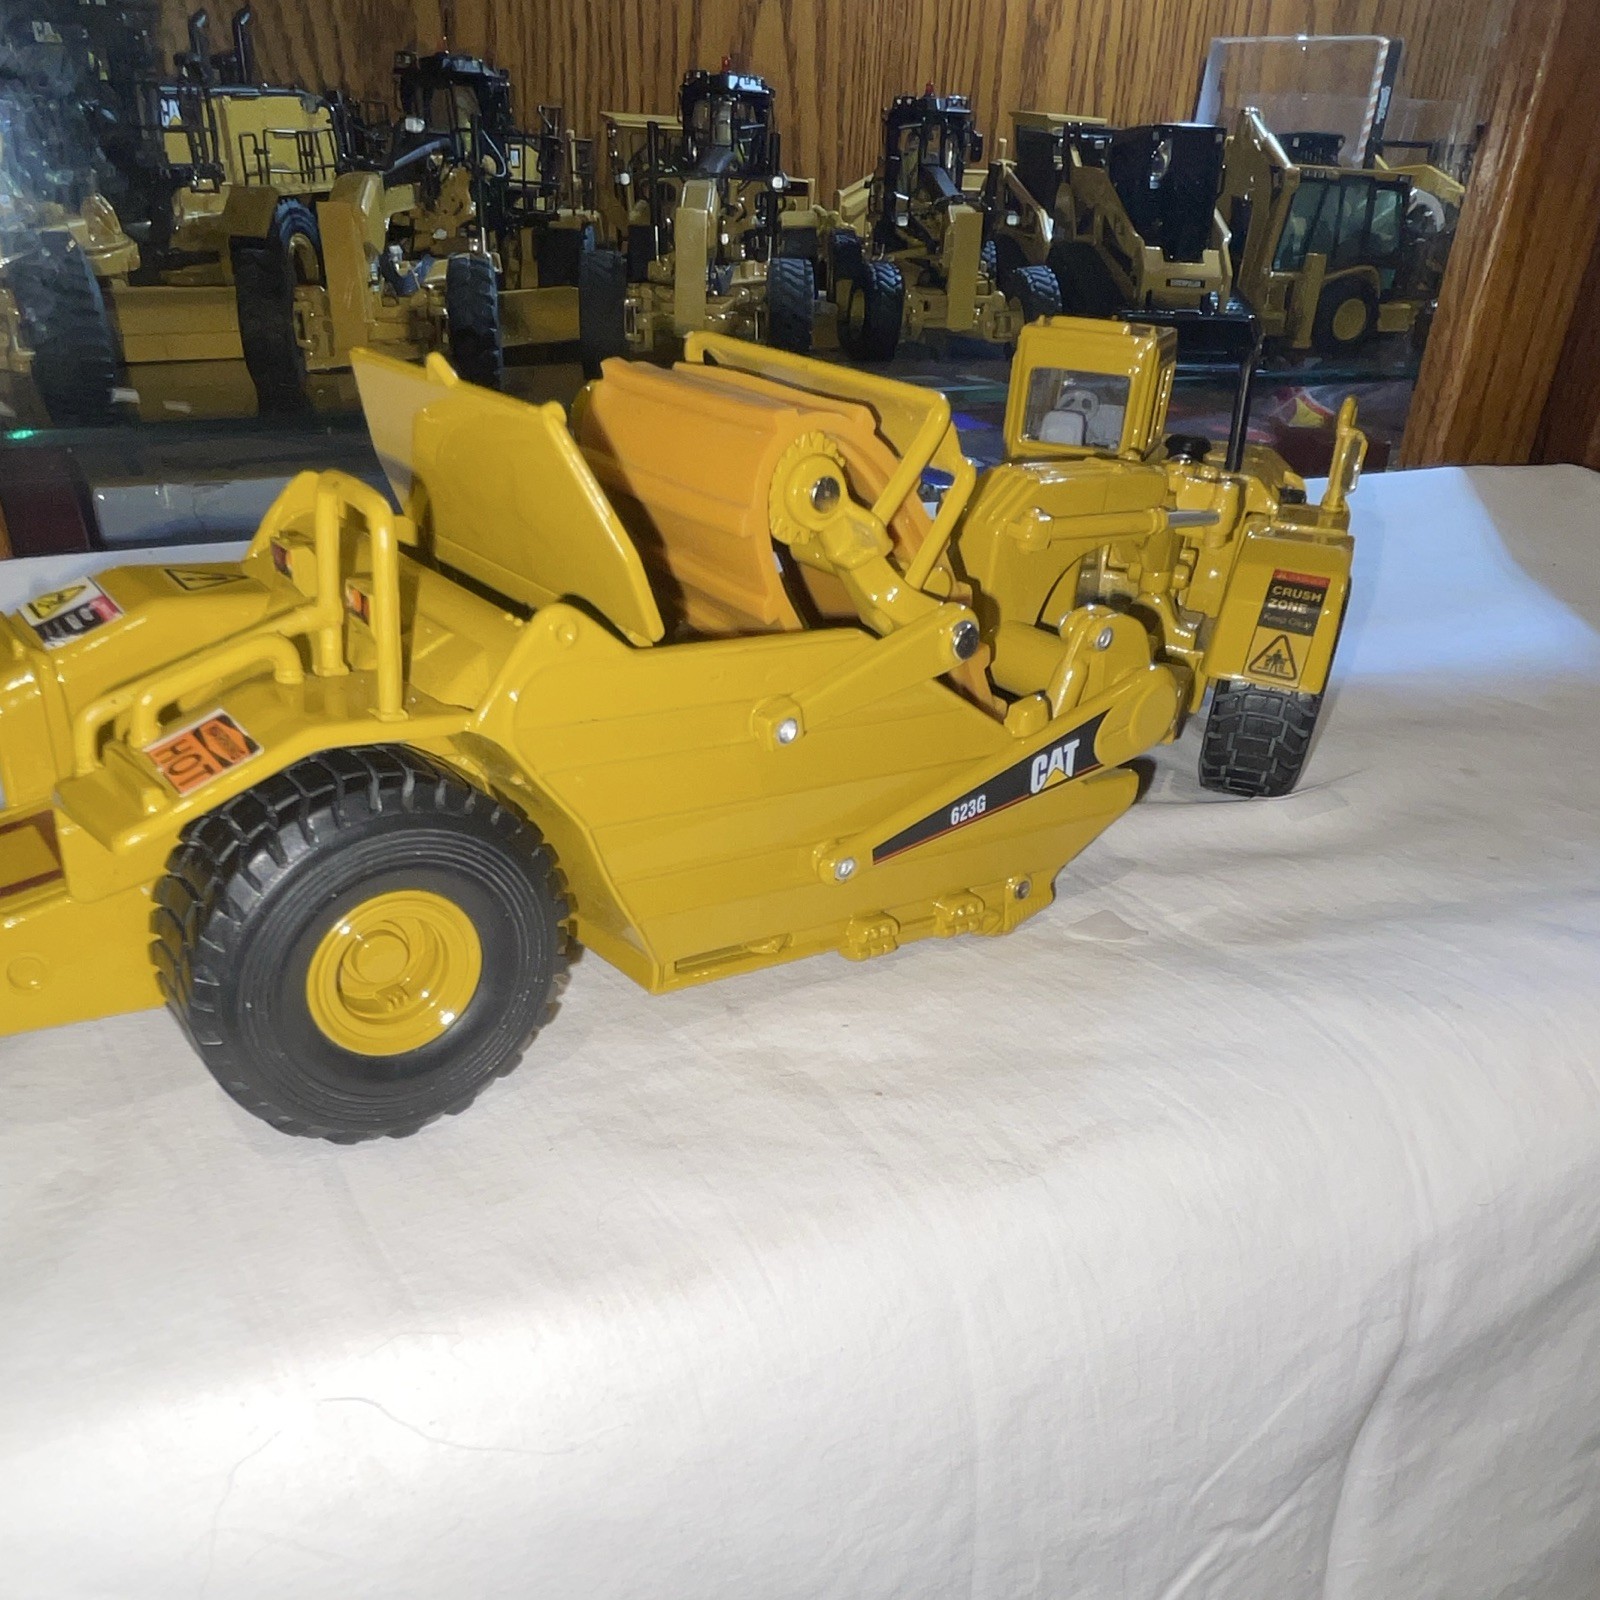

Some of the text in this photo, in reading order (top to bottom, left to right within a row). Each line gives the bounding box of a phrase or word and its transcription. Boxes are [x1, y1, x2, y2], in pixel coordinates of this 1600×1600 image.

[160, 98, 182, 129] CA
[1267, 597, 1308, 614] ZONE
[1272, 585, 1322, 603] CRUSH
[155, 738, 215, 787] HOT
[1030, 738, 1081, 794] CAT
[950, 794, 987, 826] 623G
